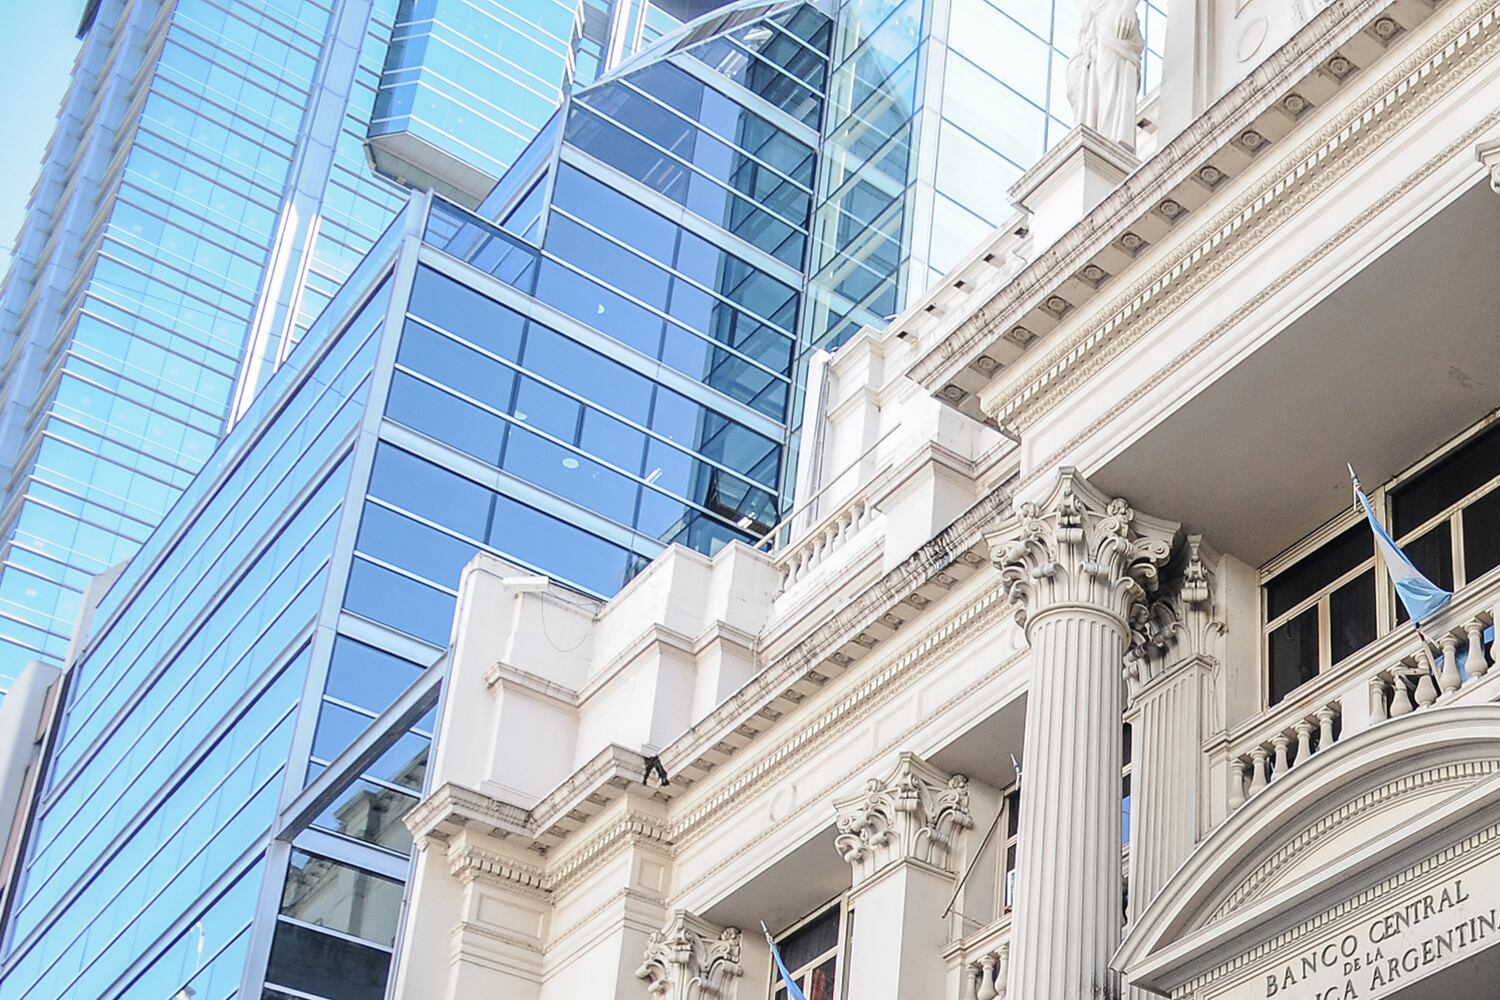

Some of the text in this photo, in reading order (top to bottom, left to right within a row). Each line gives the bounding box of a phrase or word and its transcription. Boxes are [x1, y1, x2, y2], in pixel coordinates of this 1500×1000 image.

[1266, 880, 1470, 998] BANCO CENTRAL
[1343, 947, 1385, 977] DE LA
